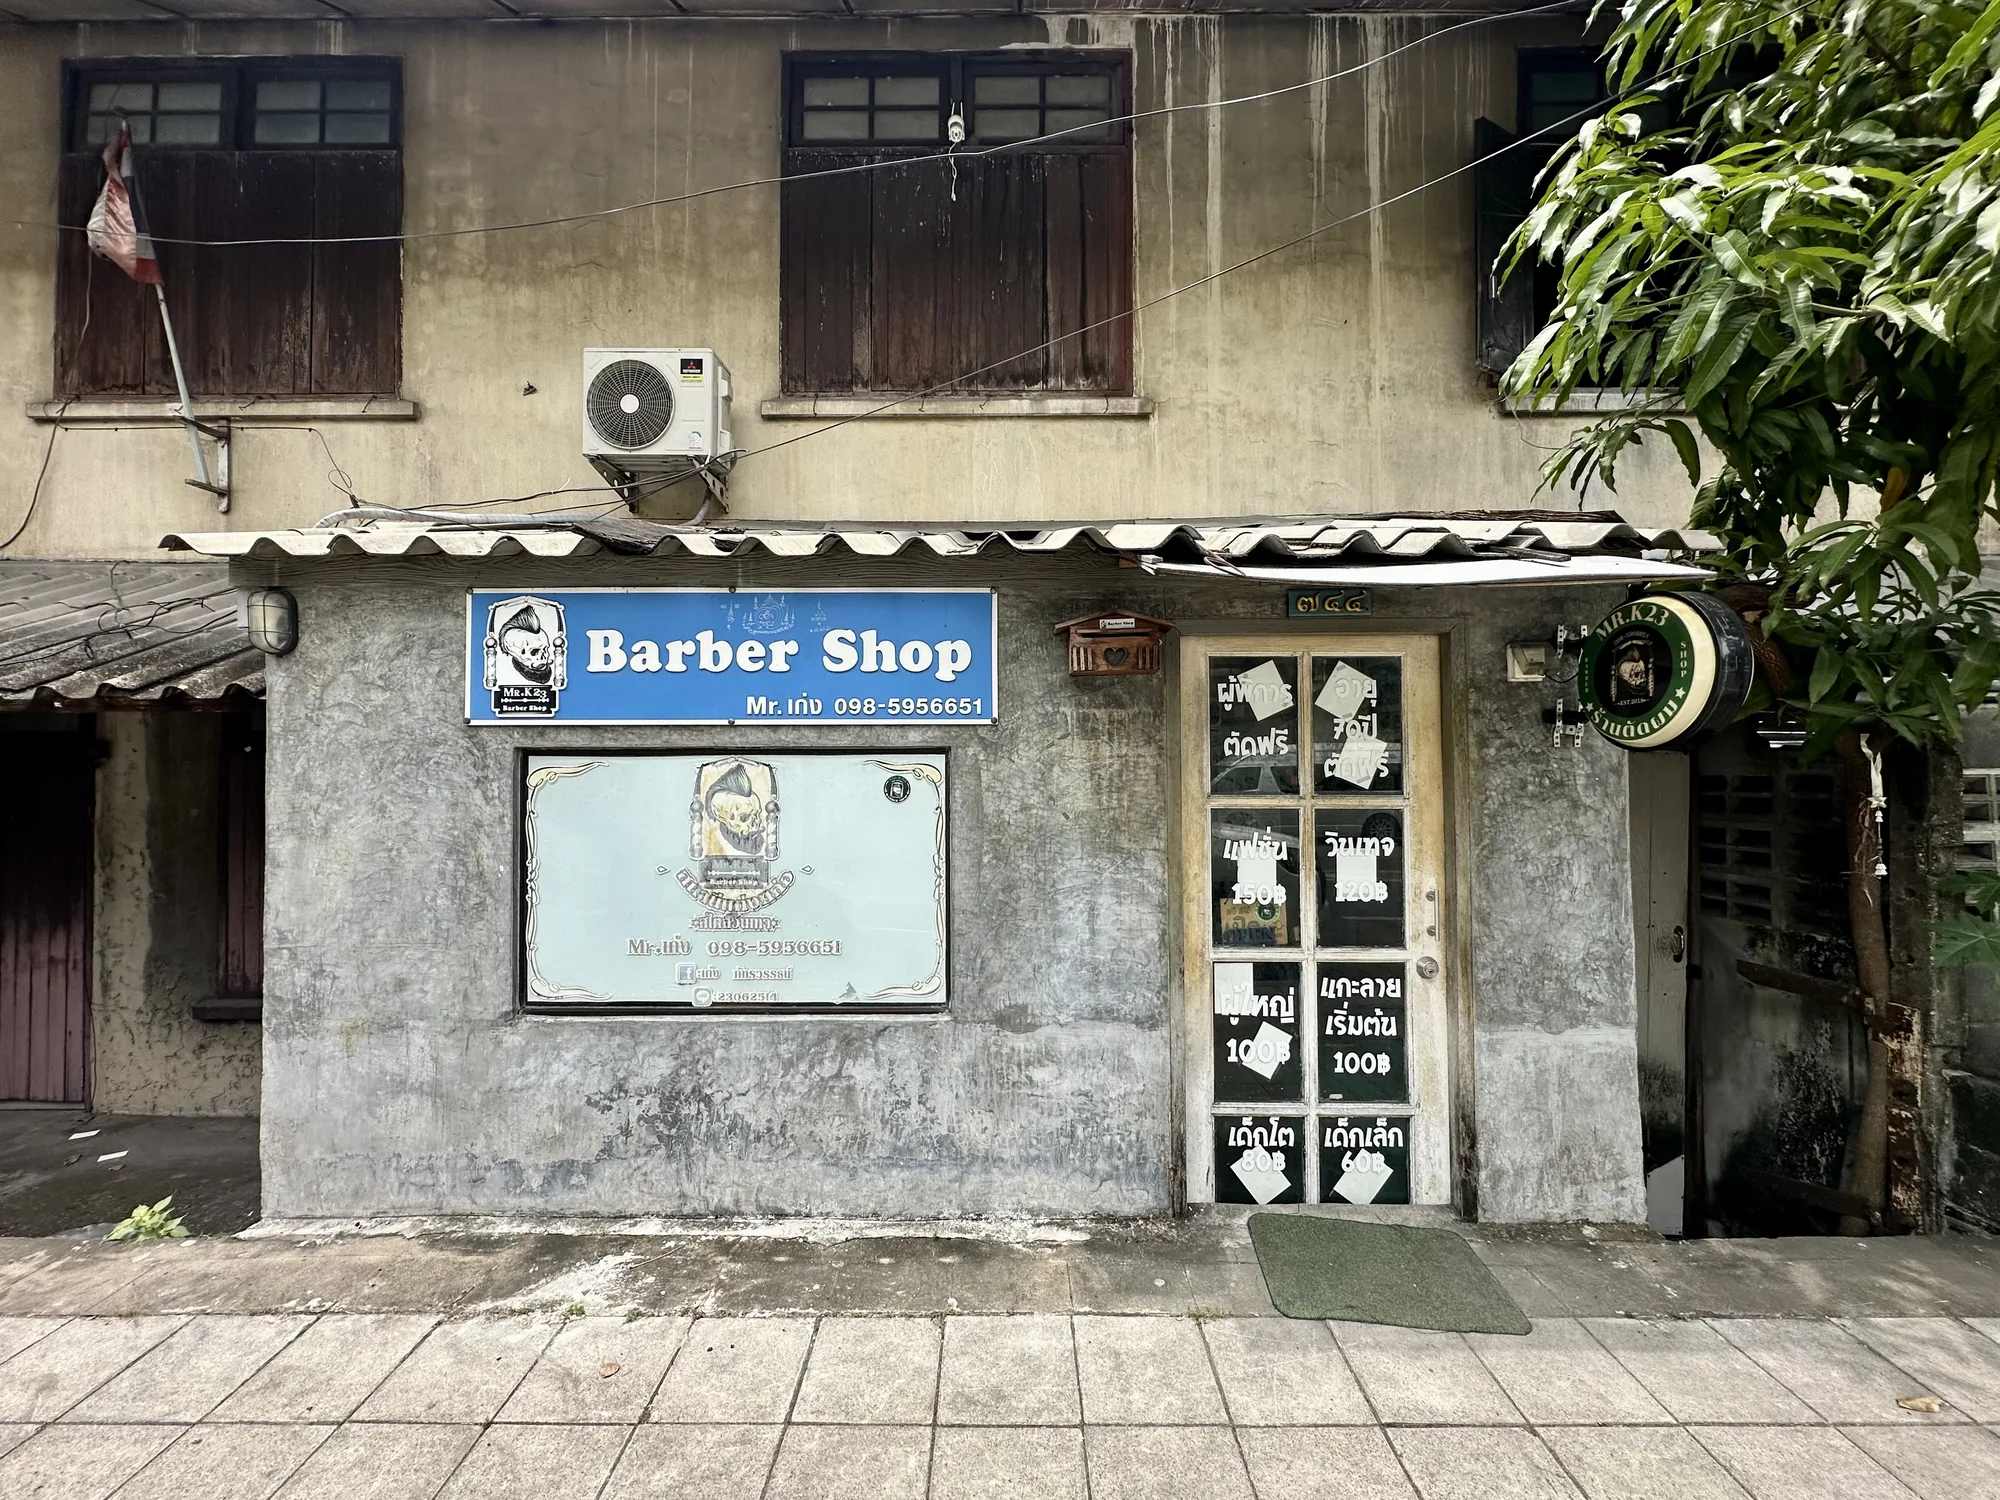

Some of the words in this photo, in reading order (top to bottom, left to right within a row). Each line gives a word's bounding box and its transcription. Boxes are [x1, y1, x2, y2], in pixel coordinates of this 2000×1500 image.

[1297, 590, 1367, 612] ๗๔๔
[1595, 603, 1669, 641] MR.K23
[586, 629, 799, 674] Barber
[822, 629, 973, 682] Shop
[787, 691, 824, 716] เก่ง
[834, 696, 983, 716] 098-5956651
[1217, 675, 1293, 711] ผู้พิการ
[1334, 677, 1377, 707] อายุ
[1333, 713, 1378, 743] 70ปี
[1590, 699, 1678, 738] ร้านตัดผม
[1223, 727, 1289, 756] ตัดฟรี
[1324, 750, 1389, 778] ตัดฟรี
[1223, 827, 1288, 861] แฟชั่น
[1324, 831, 1395, 858] วินเทจ
[707, 940, 842, 956] 098-5956651
[1320, 977, 1402, 999] แกะลาย
[1218, 983, 1295, 1025] ผู้ใหญ่
[1325, 1002, 1397, 1037] เริ่มต้น
[1228, 1117, 1295, 1147] เด็กโต
[1324, 1117, 1403, 1148] เด็กเล็ก
